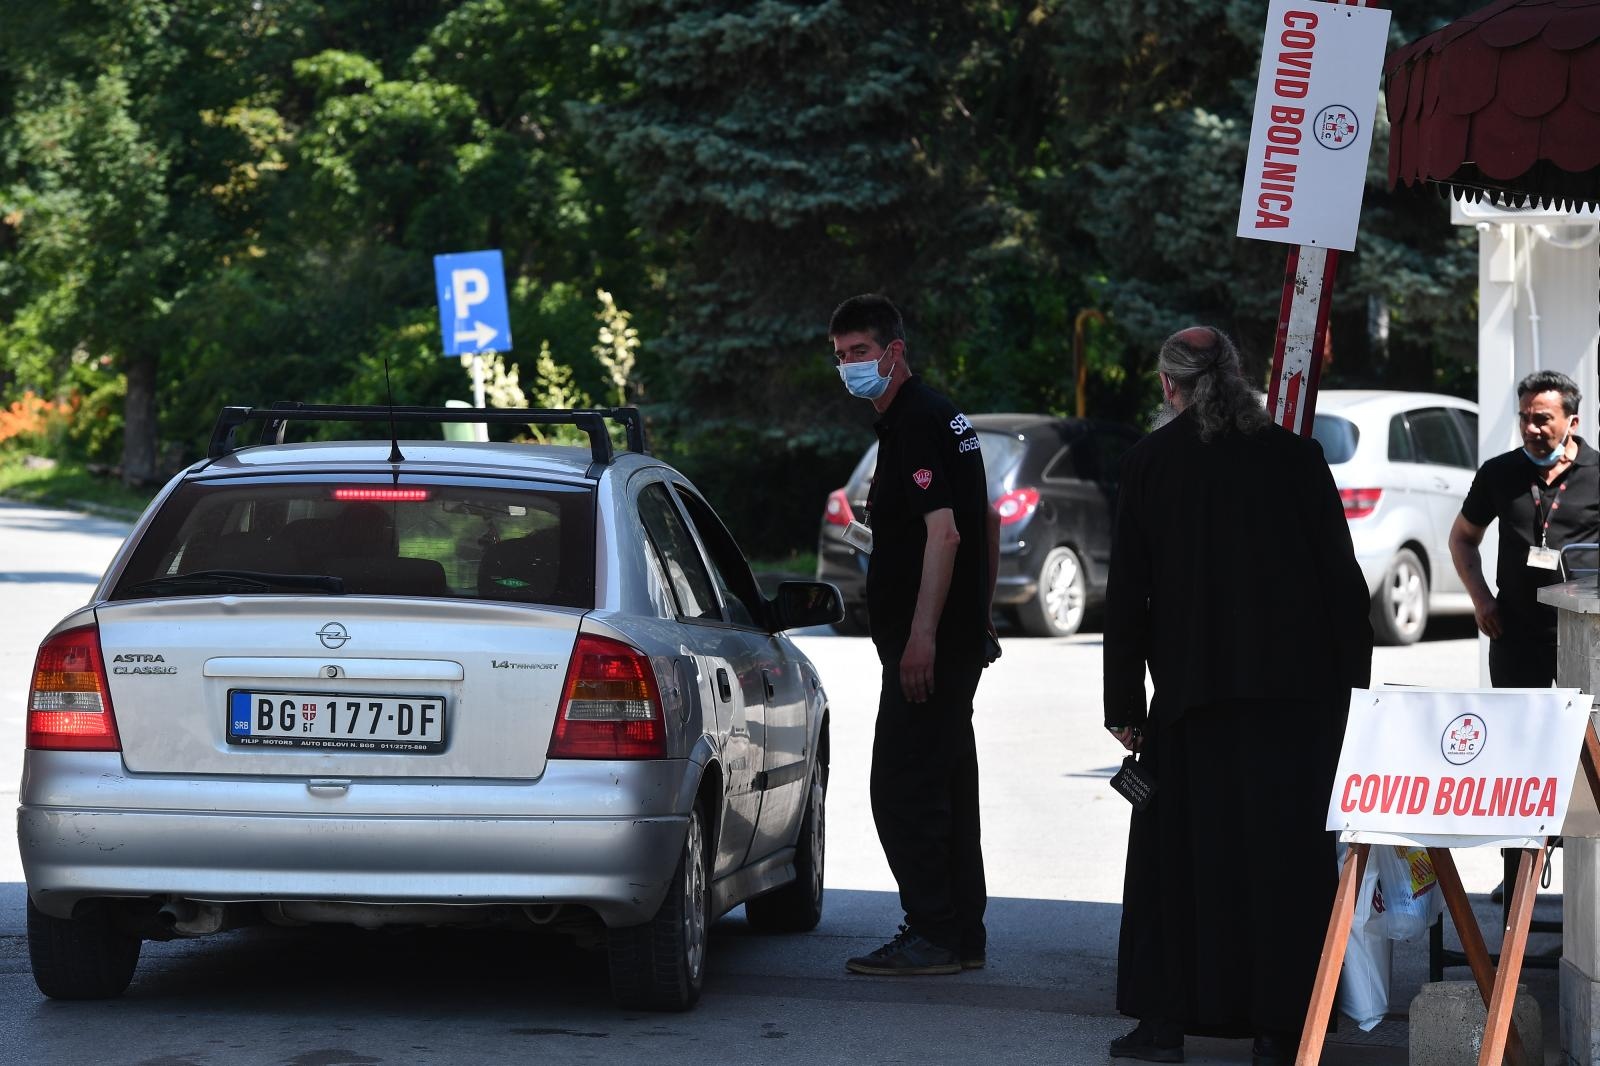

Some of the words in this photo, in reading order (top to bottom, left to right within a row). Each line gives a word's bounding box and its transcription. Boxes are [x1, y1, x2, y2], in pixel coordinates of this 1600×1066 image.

[1274, 10, 1319, 99] COVID
[1254, 105, 1305, 229] BOLNICA
[452, 267, 490, 319] P
[113, 653, 165, 663] ASTRA
[113, 665, 178, 675] CLASSIC
[234, 720, 249, 730] SRB
[257, 698, 296, 732] BG
[1340, 773, 1430, 815] COVID
[1433, 776, 1558, 818] BOLNICA
